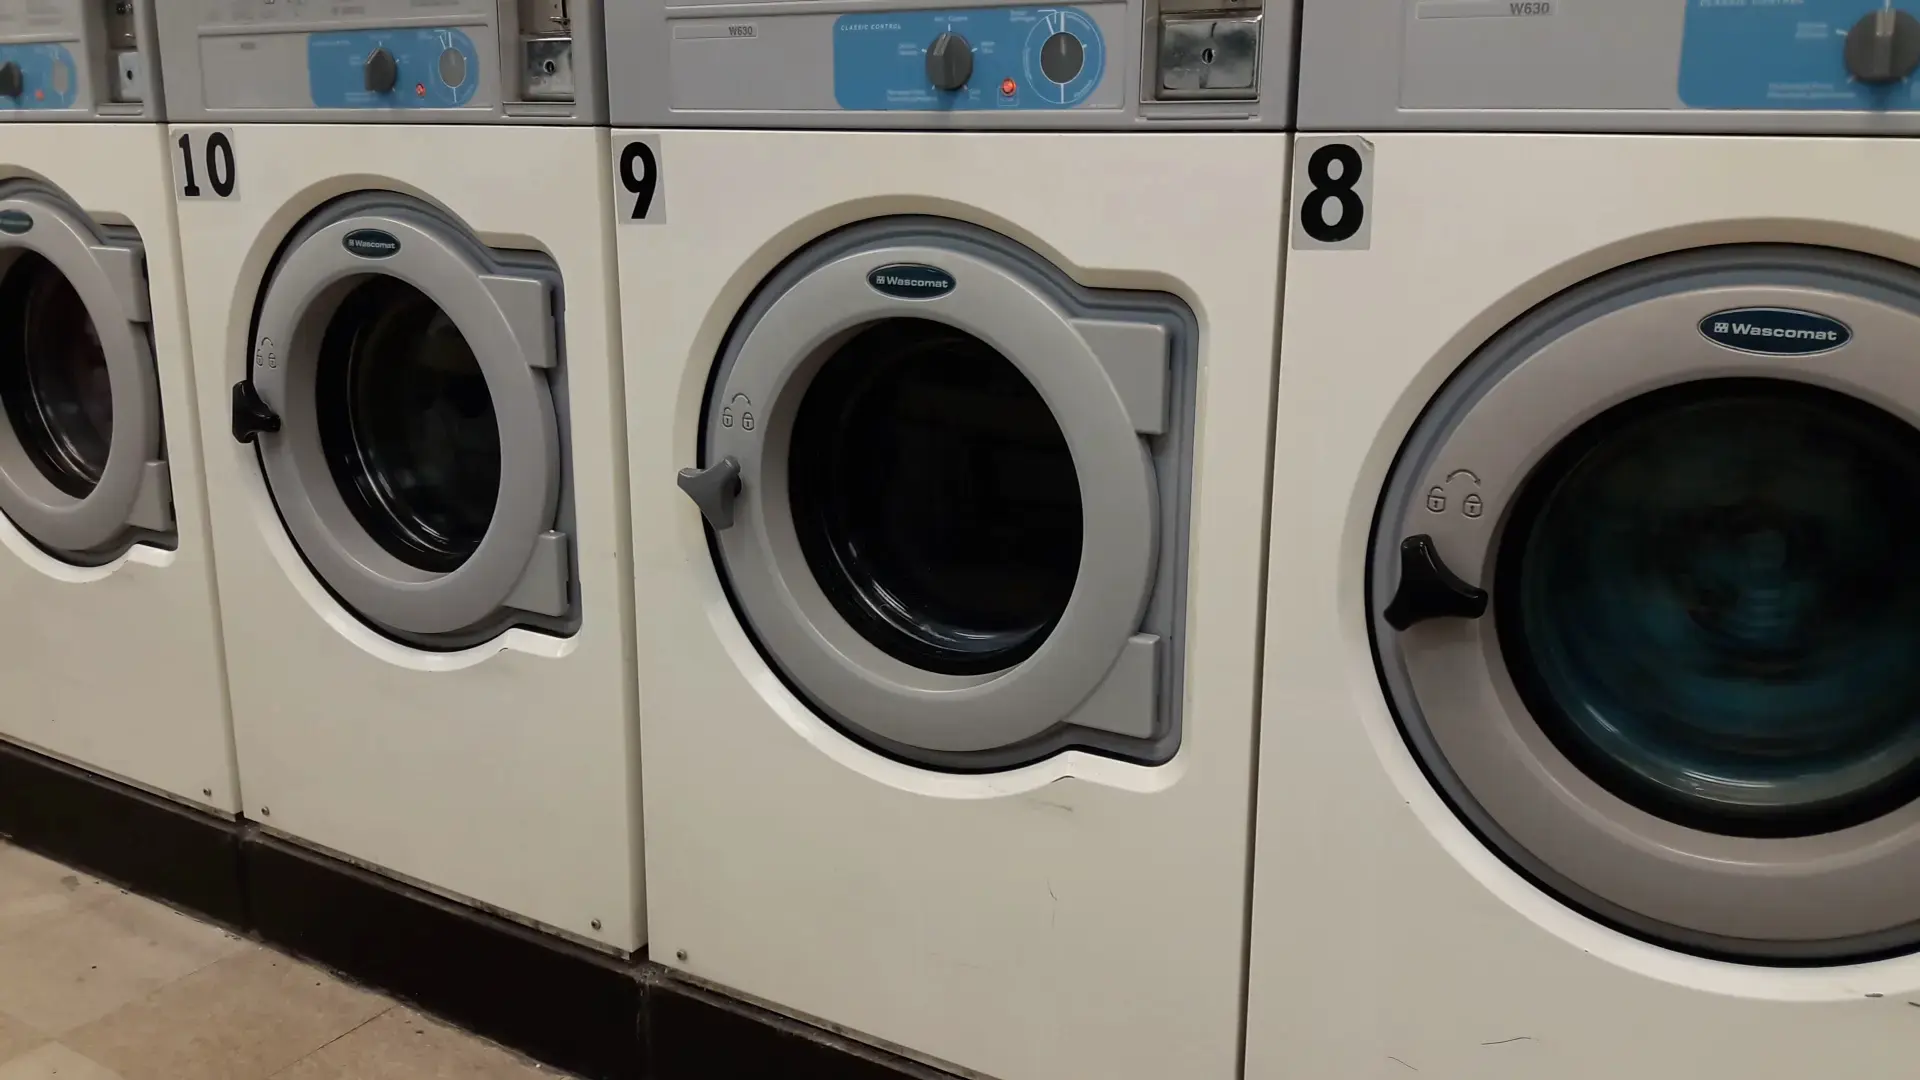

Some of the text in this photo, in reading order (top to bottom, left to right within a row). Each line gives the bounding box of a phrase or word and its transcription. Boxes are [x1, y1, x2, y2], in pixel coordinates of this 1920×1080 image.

[1510, 2, 1550, 15] W630
[728, 25, 753, 36] W630
[178, 131, 236, 198] 10
[619, 141, 658, 220] 9
[1300, 143, 1365, 243] 8
[355, 239, 396, 249] Wascomat
[887, 276, 949, 288] Wascomat
[1732, 322, 1837, 341] Wascomat
